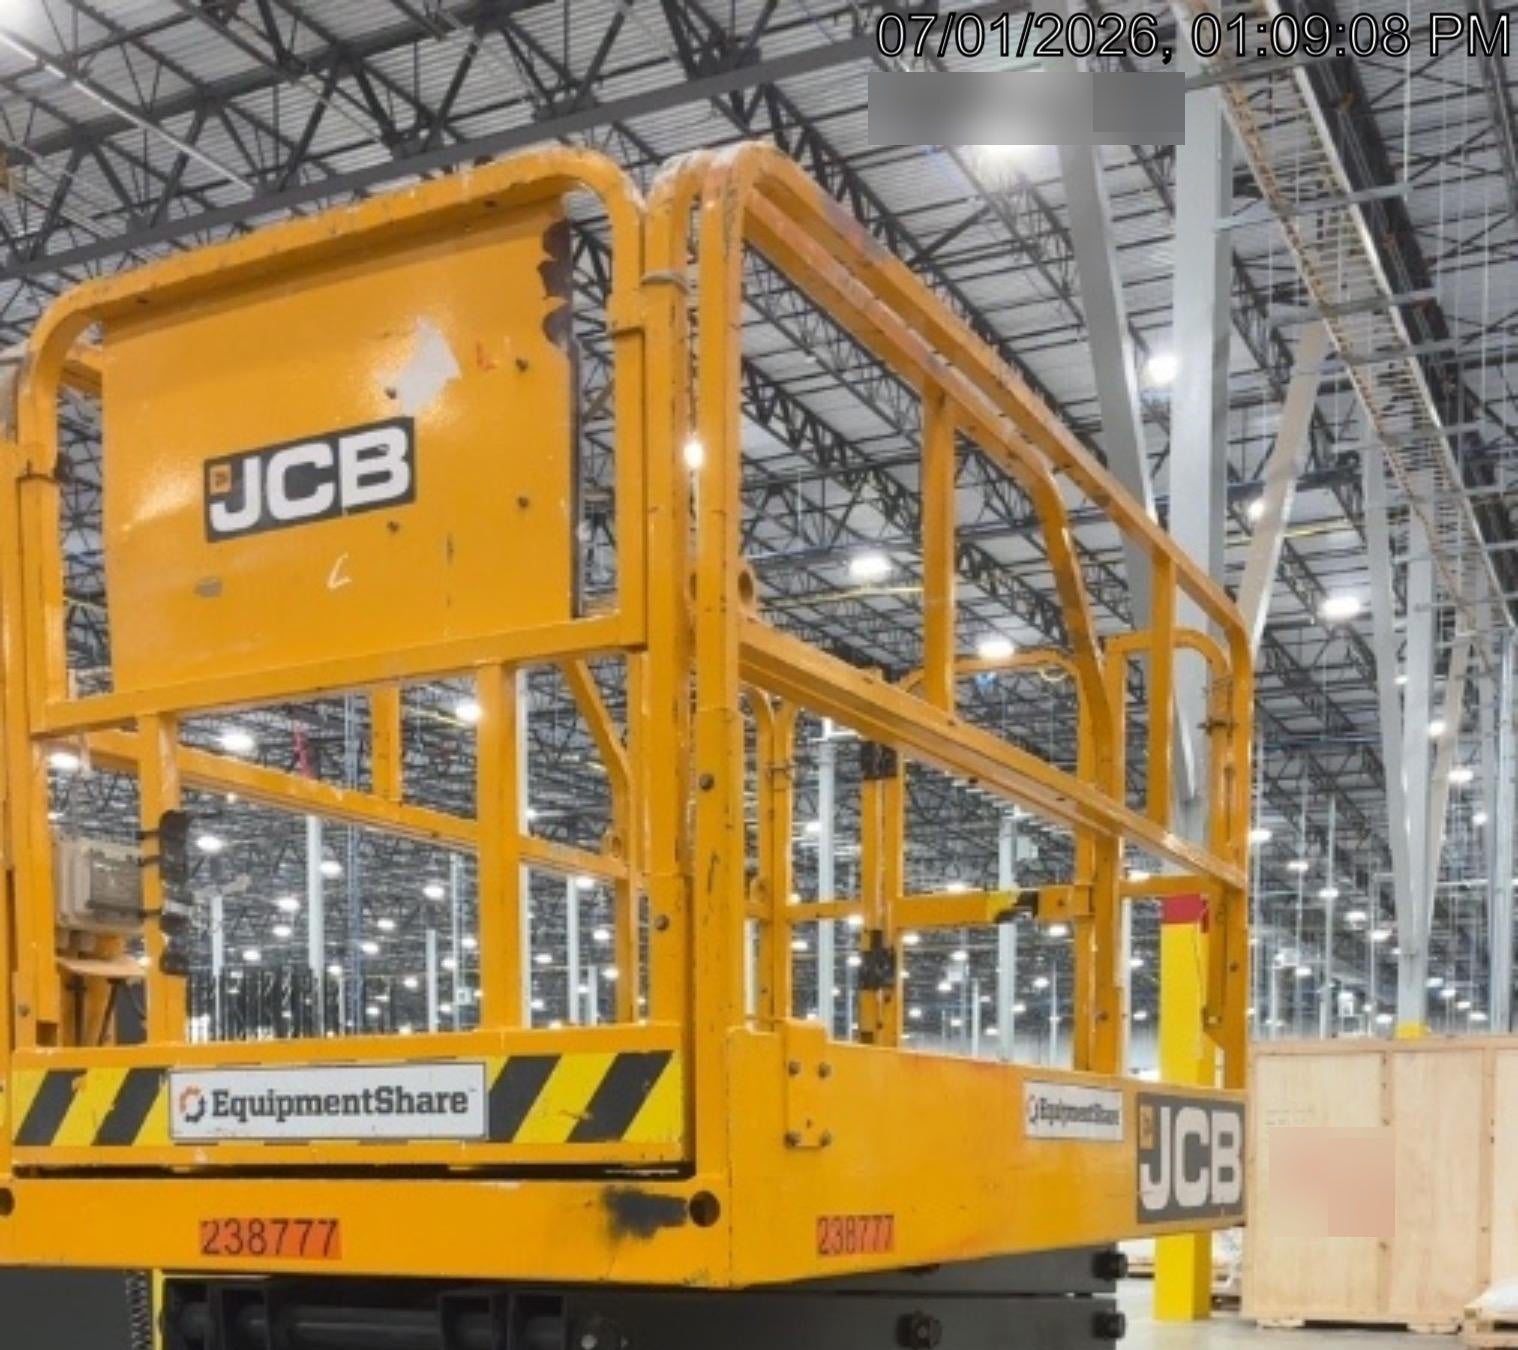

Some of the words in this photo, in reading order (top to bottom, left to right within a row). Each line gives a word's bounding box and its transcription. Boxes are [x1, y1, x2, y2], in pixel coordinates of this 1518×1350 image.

[209, 425, 410, 532] JCB
[212, 1085, 469, 1123] EquipmentShare
[1139, 1106, 1242, 1210] JCB
[201, 1218, 338, 1257] 238777
[817, 1214, 894, 1255] 238777
